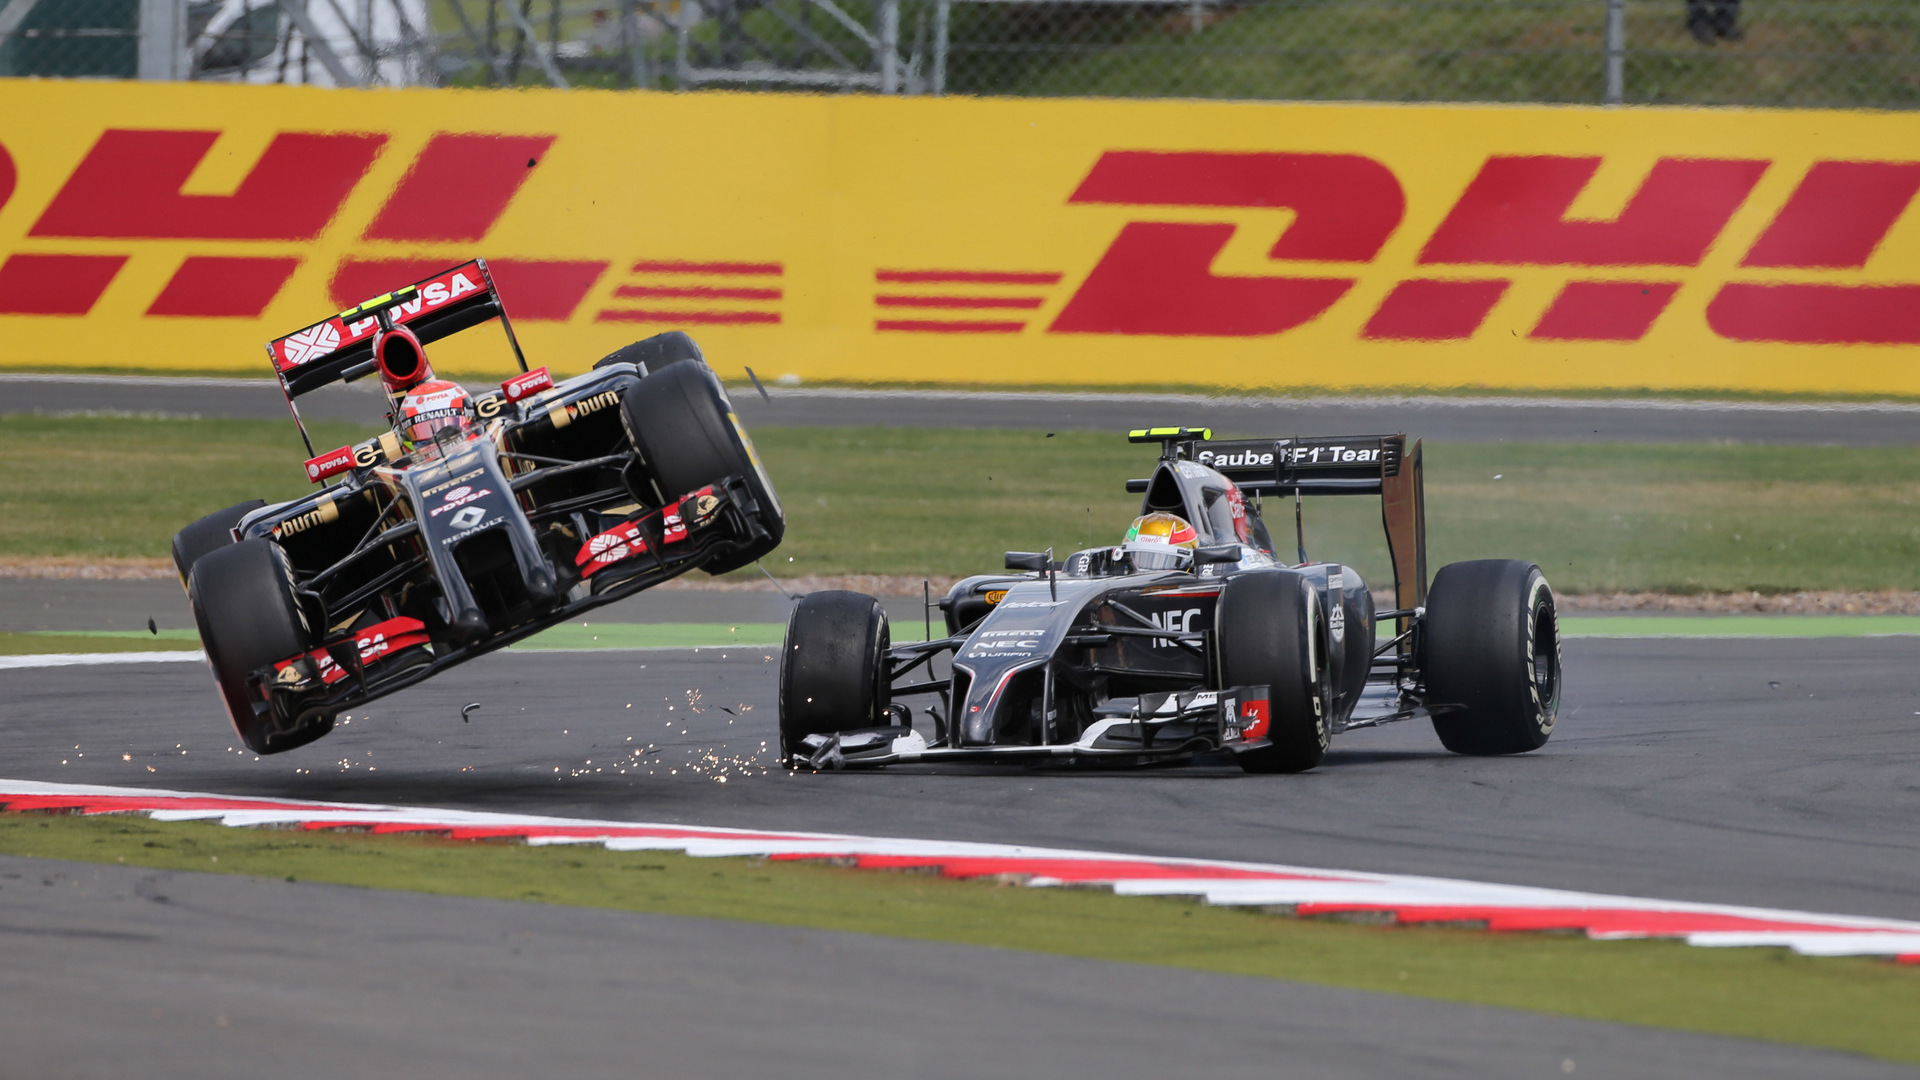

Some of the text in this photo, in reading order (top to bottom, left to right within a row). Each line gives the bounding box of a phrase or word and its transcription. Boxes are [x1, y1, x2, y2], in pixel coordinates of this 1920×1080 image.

[521, 374, 549, 391] PDVSA
[414, 408, 458, 424] RENAULT
[576, 391, 620, 417] burn
[319, 455, 350, 472] PDVSA
[430, 488, 493, 518] PDVSA
[281, 509, 324, 537] burn
[442, 516, 505, 545] RENAULT
[1152, 608, 1203, 649] NEC
[972, 640, 1040, 650] NEC
